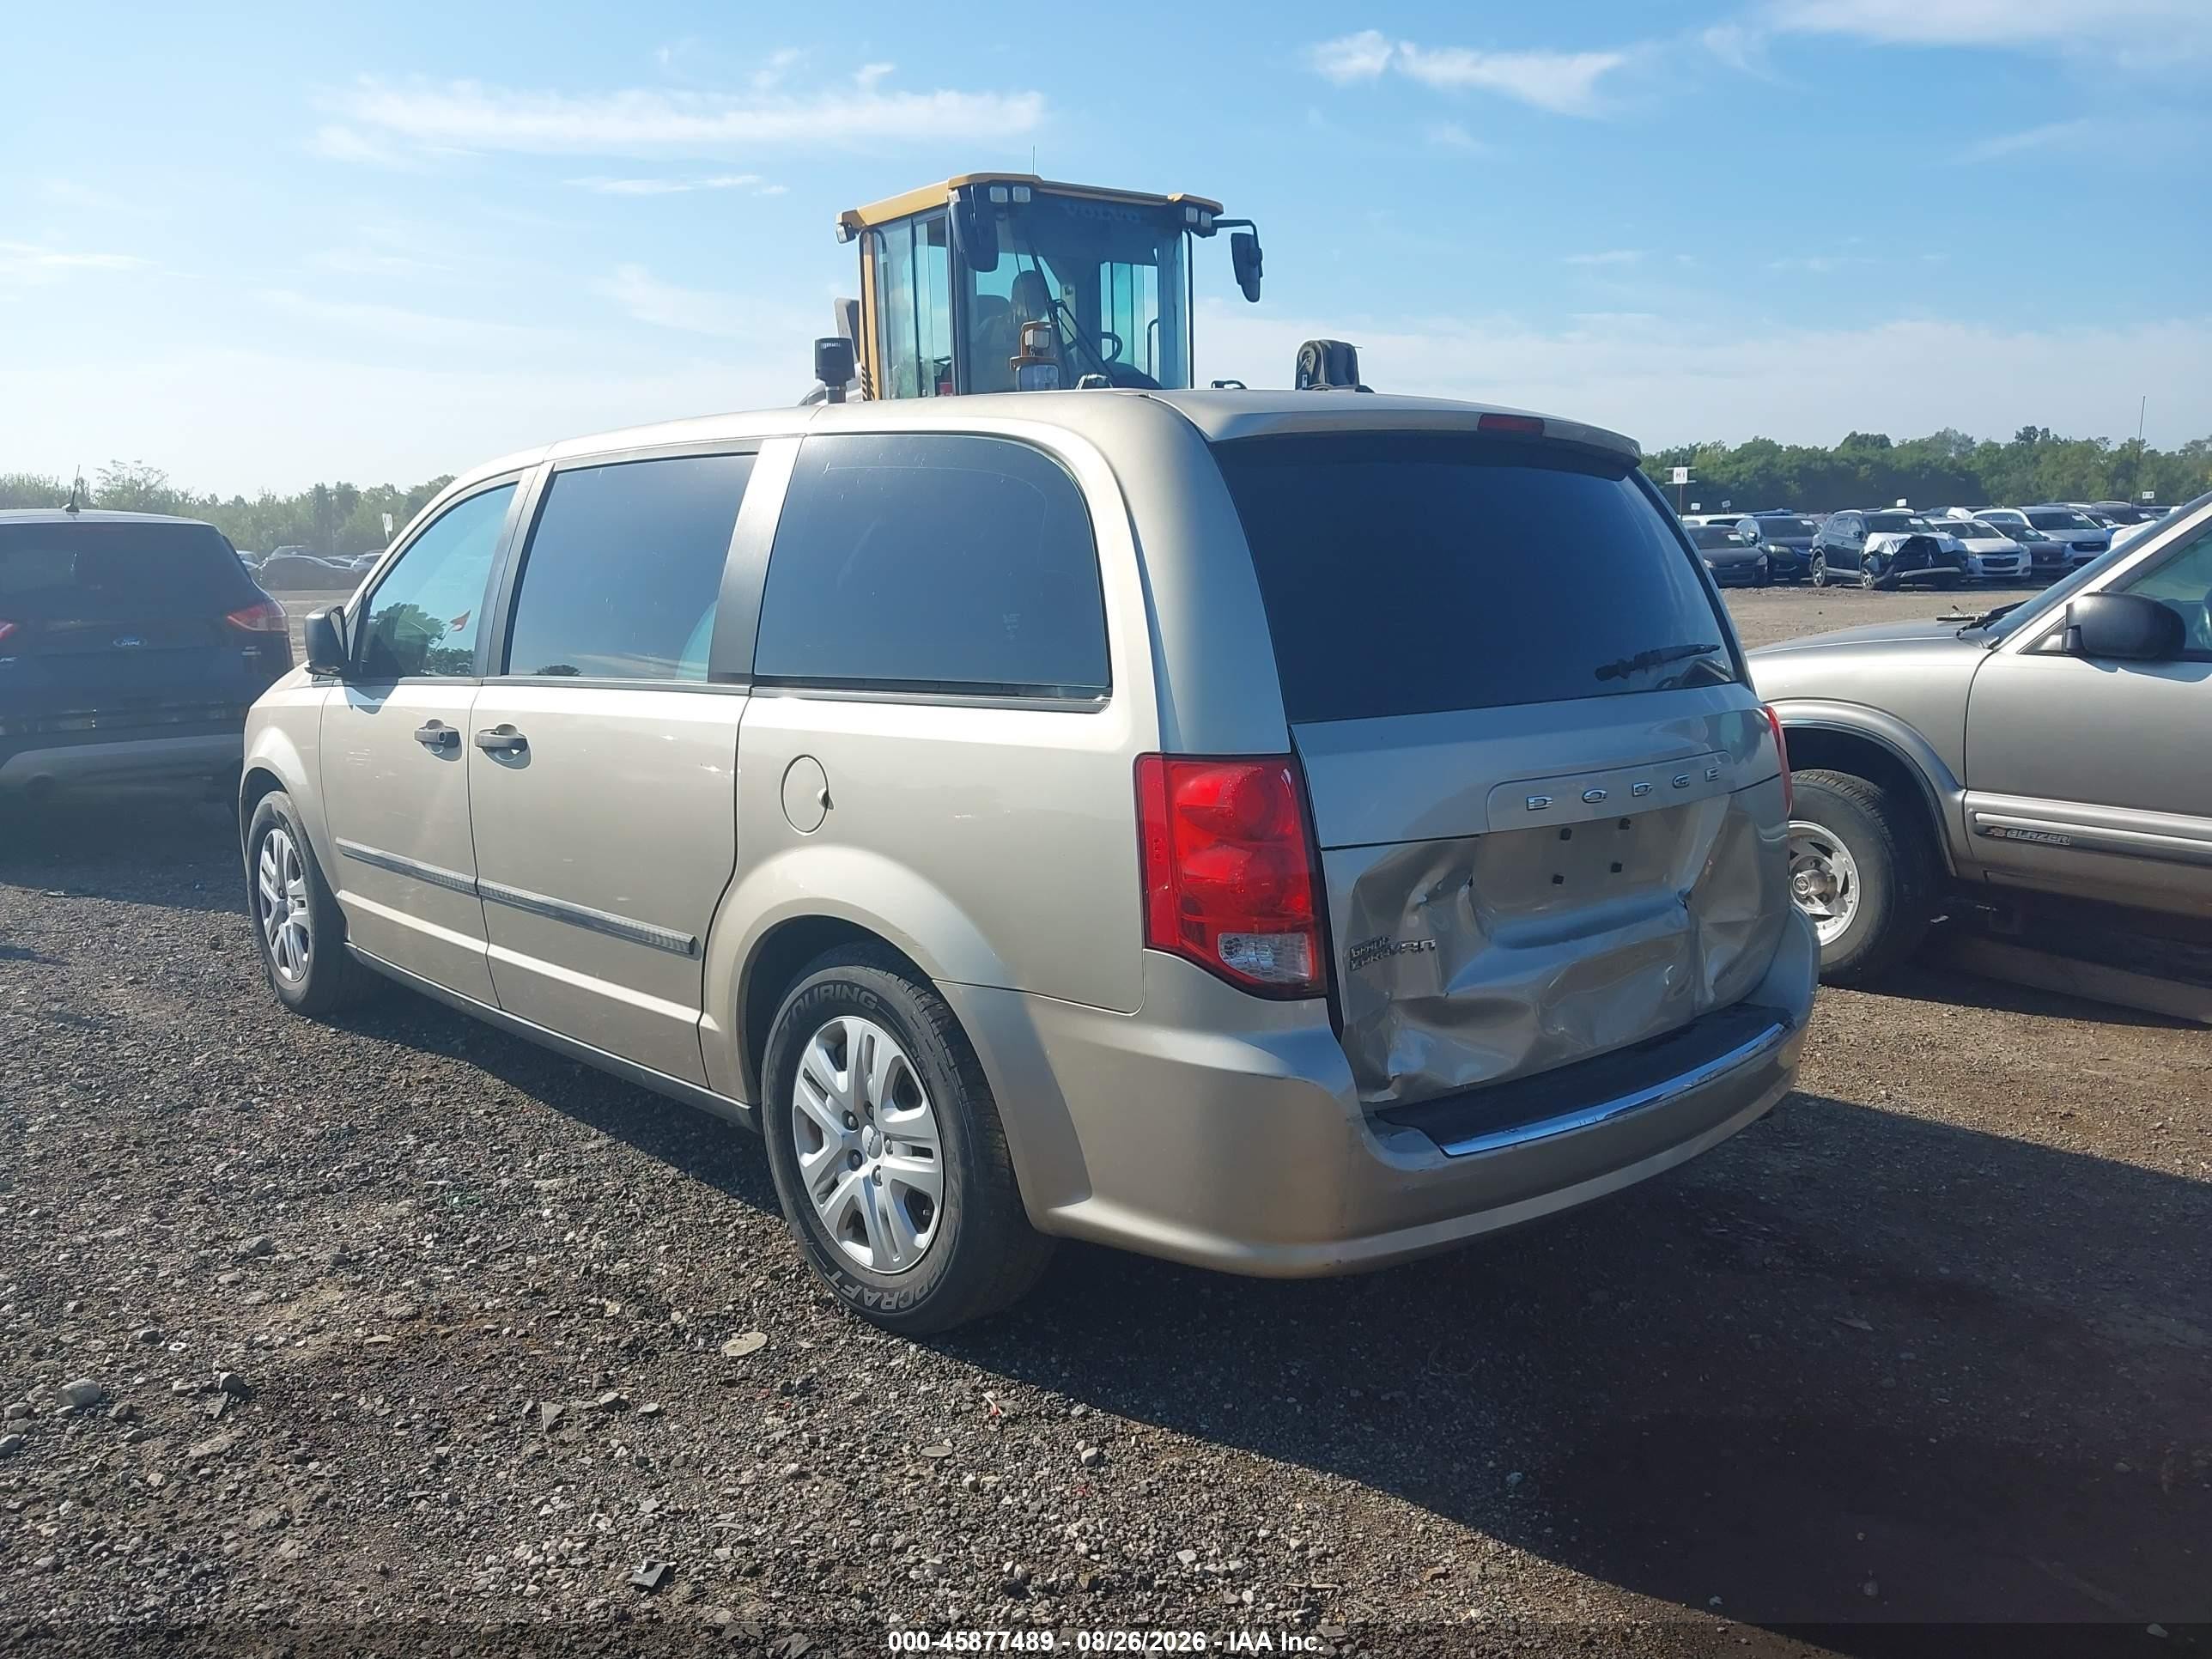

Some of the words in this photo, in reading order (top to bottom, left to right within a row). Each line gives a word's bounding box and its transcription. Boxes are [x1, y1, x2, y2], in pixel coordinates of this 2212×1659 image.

[1526, 766, 1720, 811] DODGE
[2006, 829, 2071, 846] BLAZER
[781, 984, 878, 1031] TOURING
